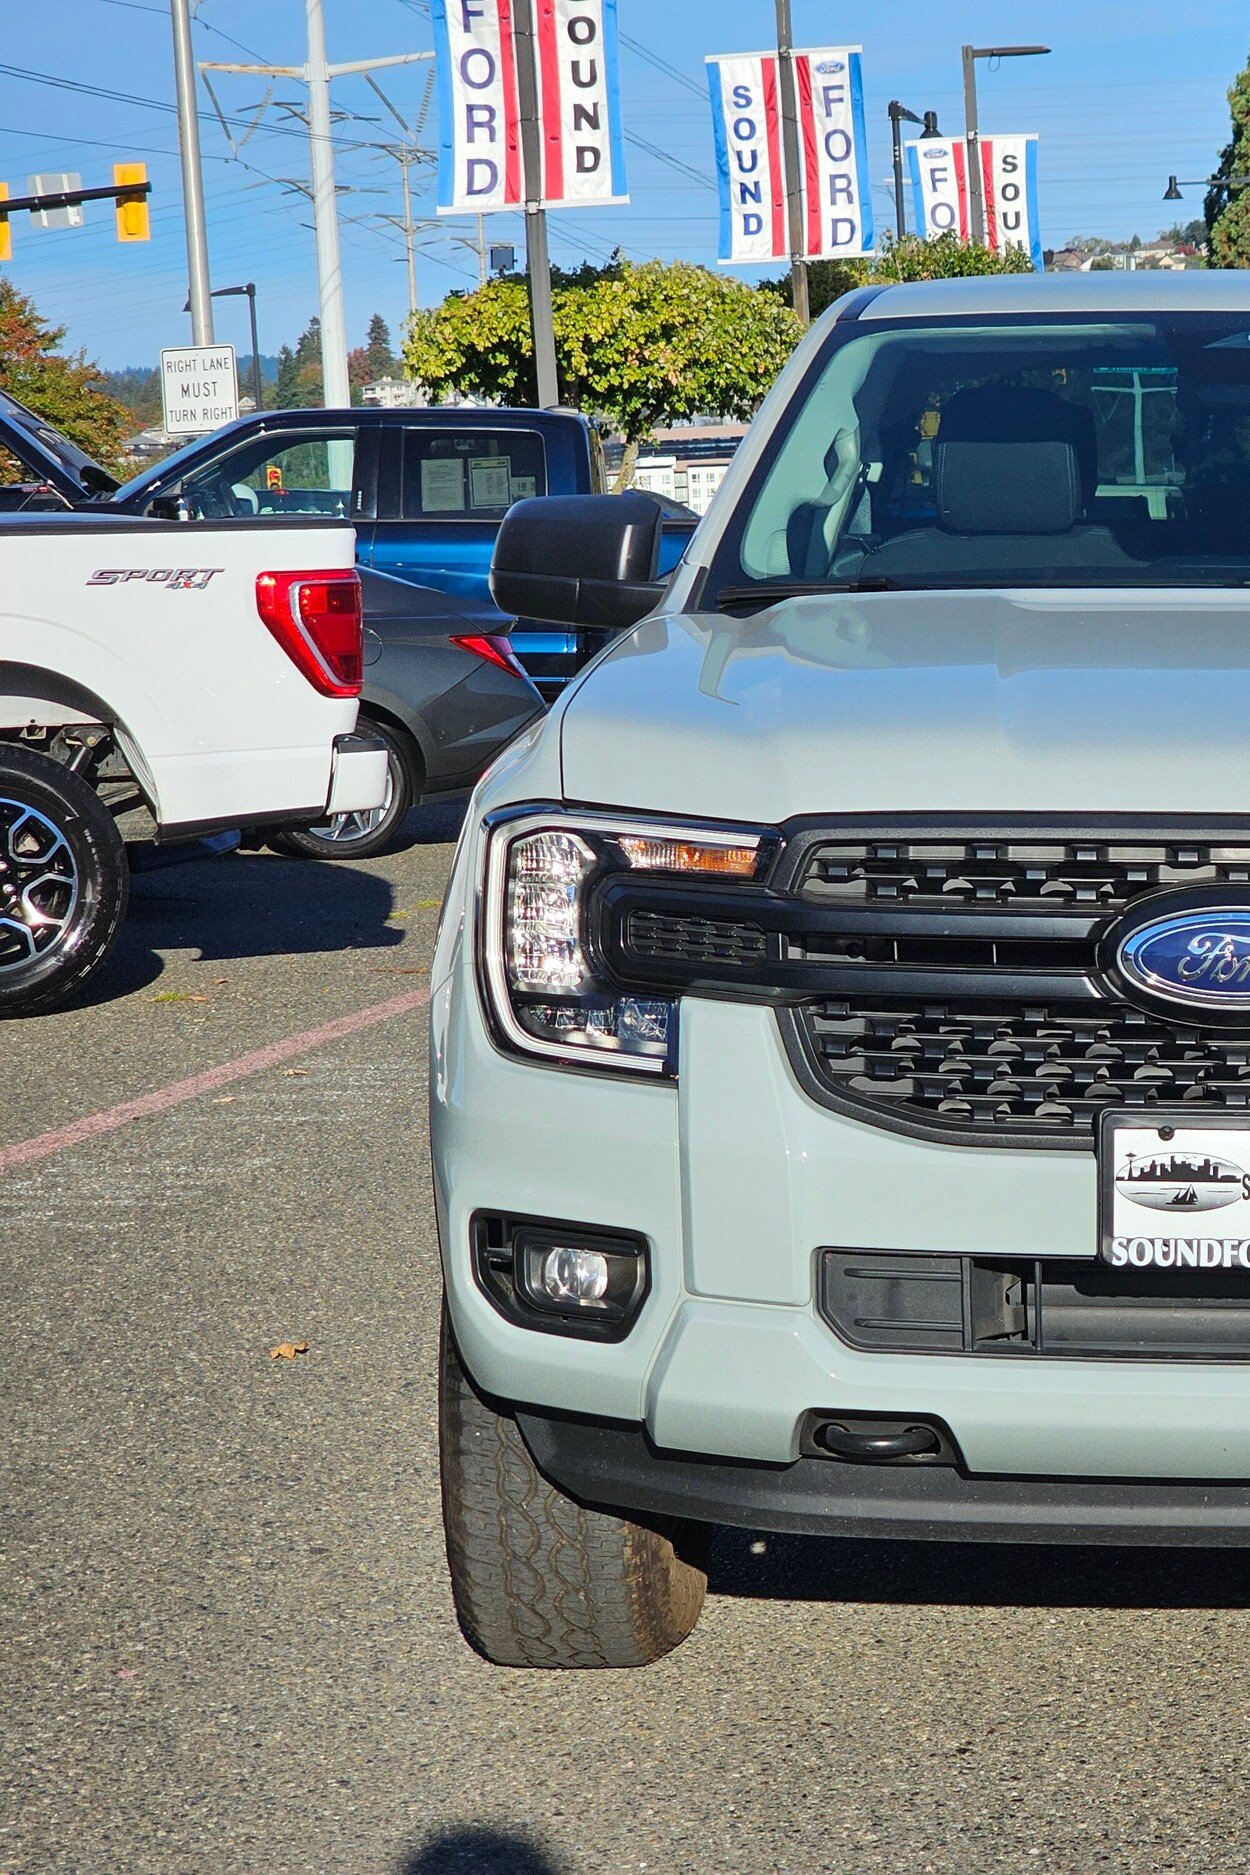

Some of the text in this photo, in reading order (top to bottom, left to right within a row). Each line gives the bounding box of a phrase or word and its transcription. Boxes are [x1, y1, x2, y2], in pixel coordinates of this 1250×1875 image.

[460, 0, 498, 195] FORD
[567, 0, 601, 173] OUND
[732, 85, 763, 236] SOUND
[822, 84, 856, 248] FORD
[929, 167, 956, 229] FO
[1001, 154, 1022, 249] SOU
[166, 357, 230, 374] RIGHT LANE
[181, 381, 218, 398] MUST
[169, 406, 233, 422] TURN RIGHT
[85, 568, 226, 586] SPORT
